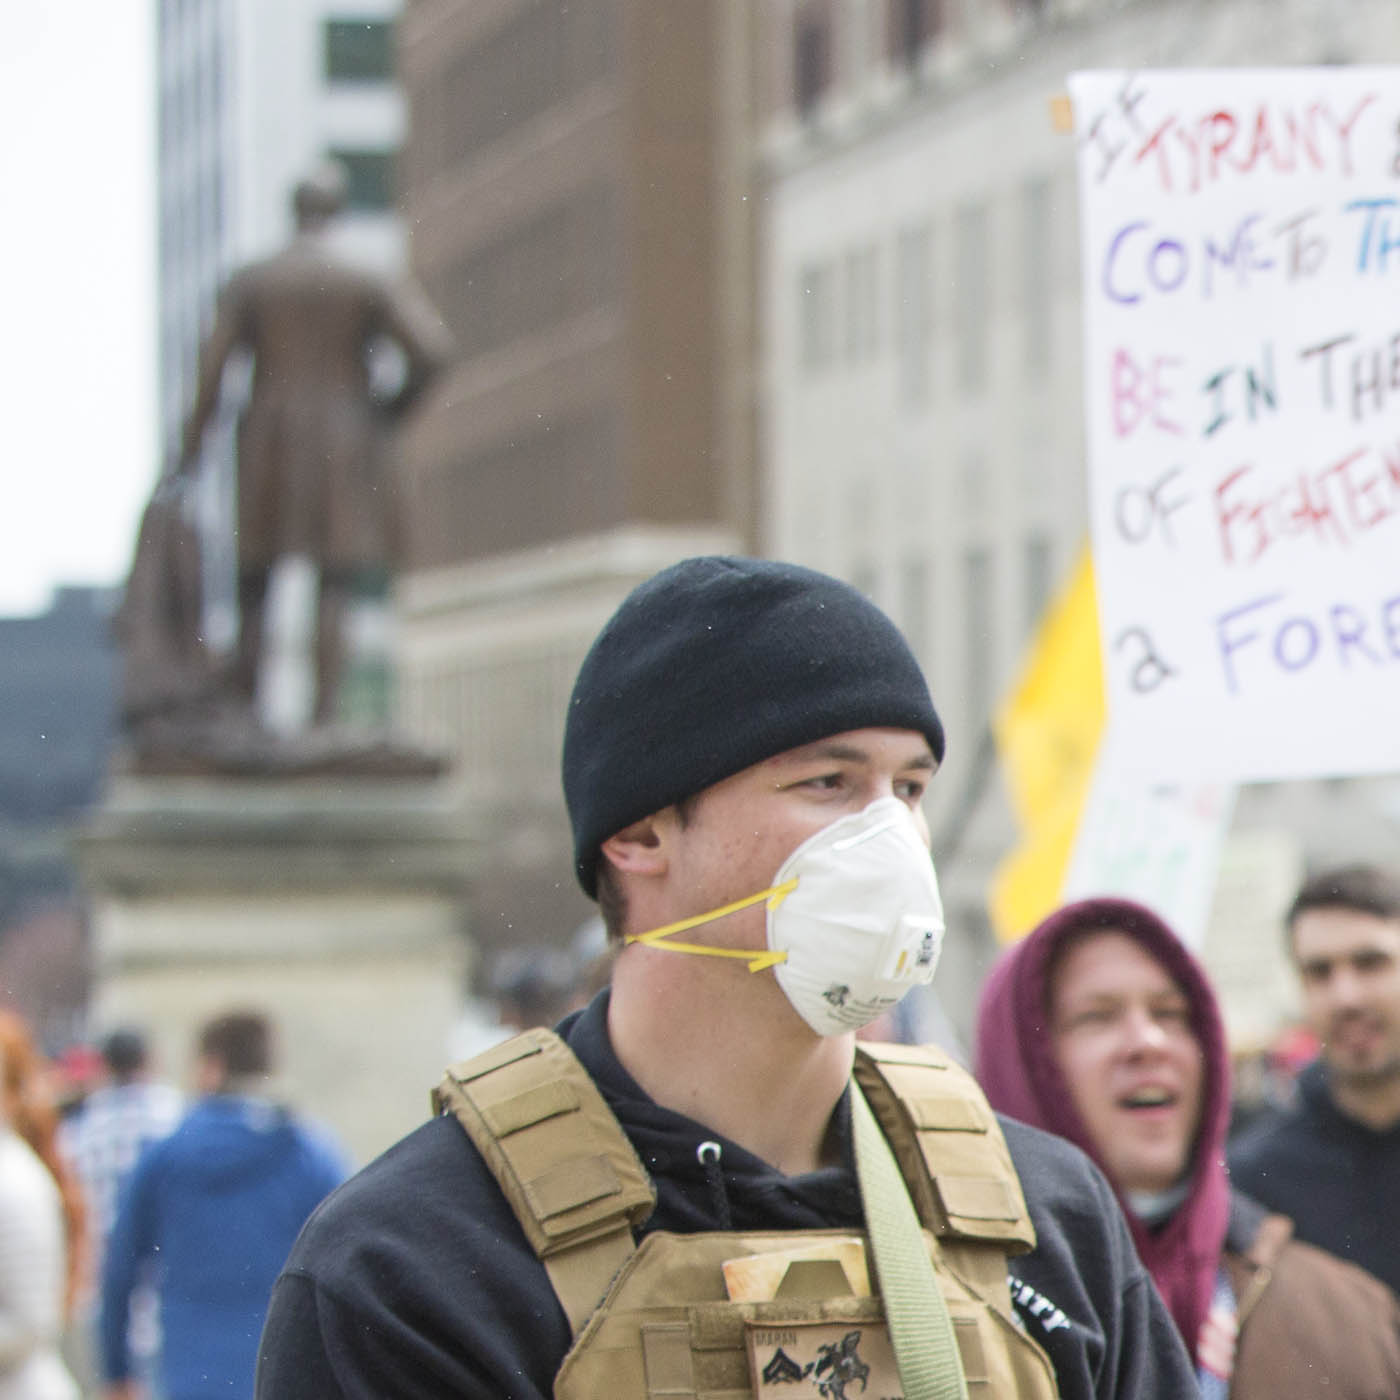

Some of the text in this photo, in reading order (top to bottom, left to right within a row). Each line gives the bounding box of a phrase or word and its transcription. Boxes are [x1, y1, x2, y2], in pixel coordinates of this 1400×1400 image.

[1100, 210, 1276, 305] COME
[1111, 347, 1186, 440] BE
[1203, 340, 1280, 440] IN
[1113, 465, 1194, 548] OF
